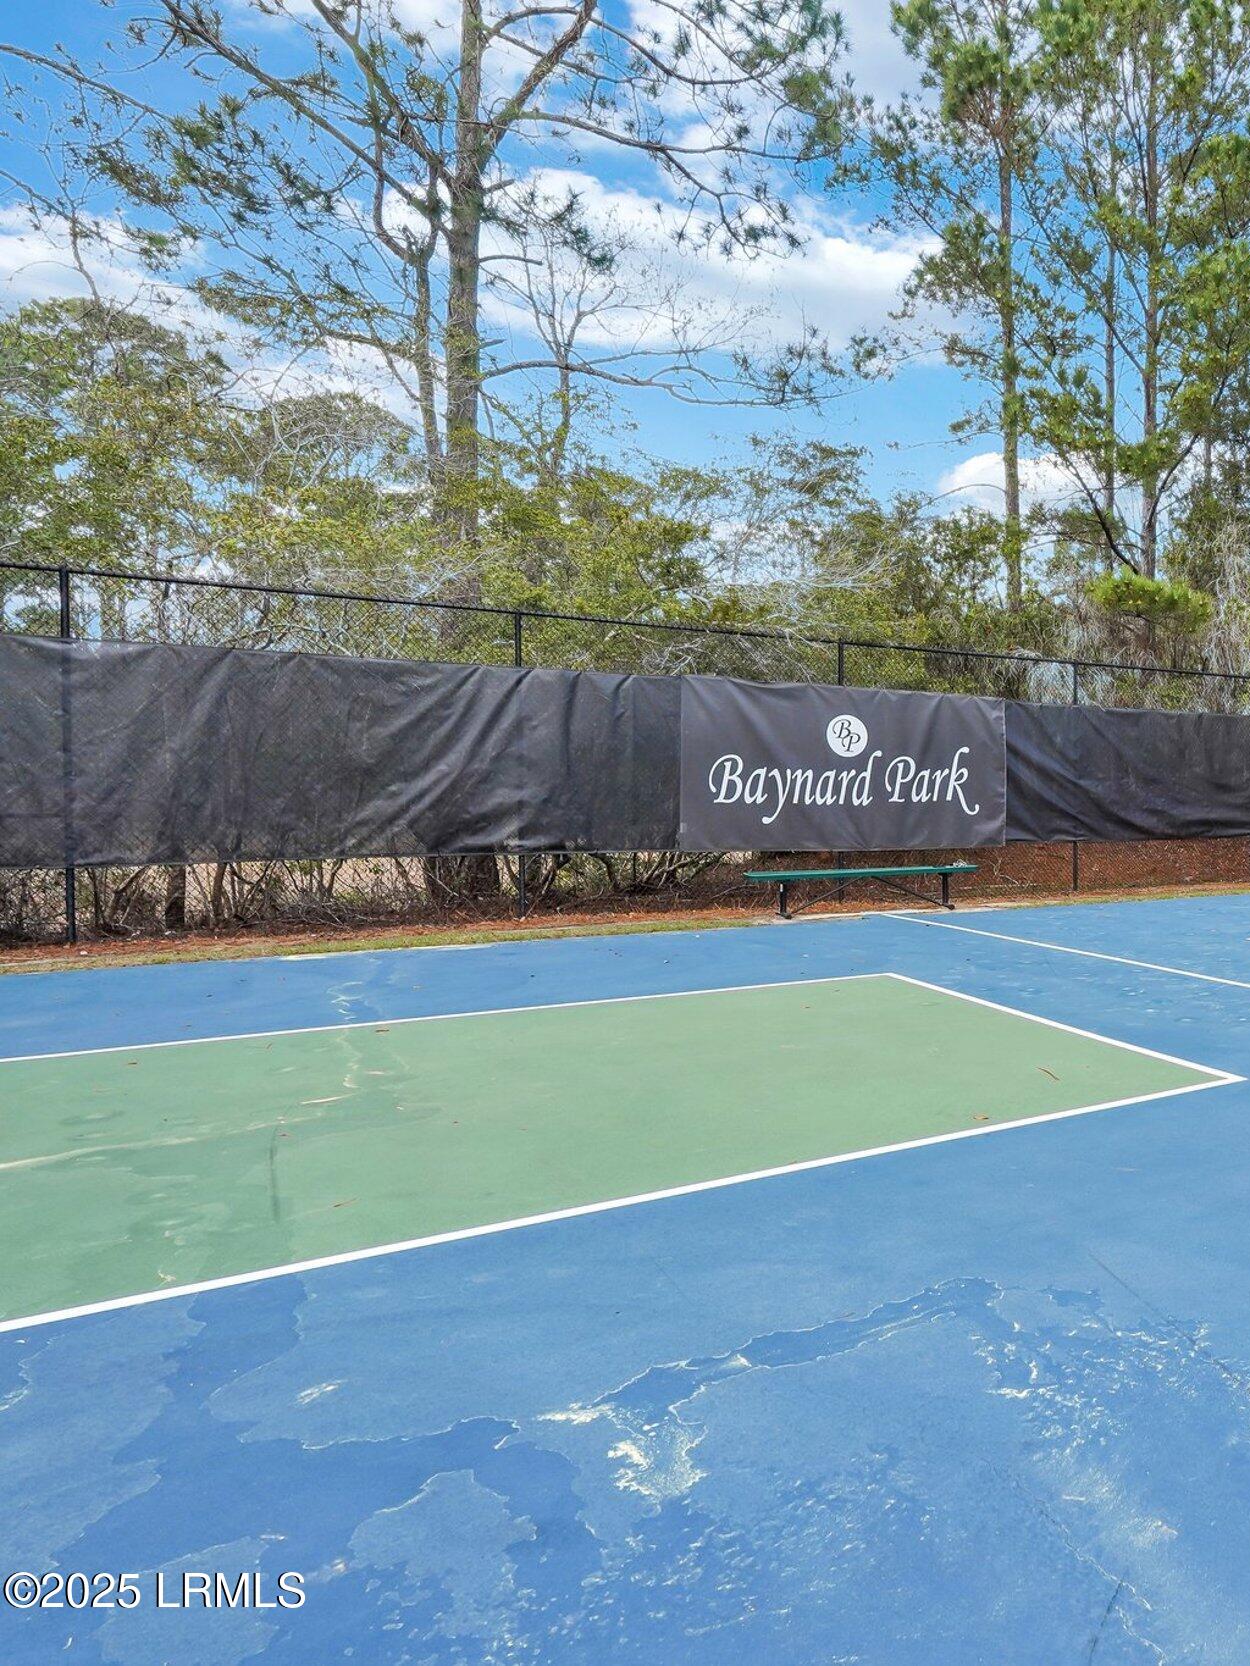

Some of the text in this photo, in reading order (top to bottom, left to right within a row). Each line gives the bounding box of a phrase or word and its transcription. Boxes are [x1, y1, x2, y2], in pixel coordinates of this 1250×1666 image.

[832, 718, 861, 753] BP
[708, 746, 980, 825] Baynard Park
